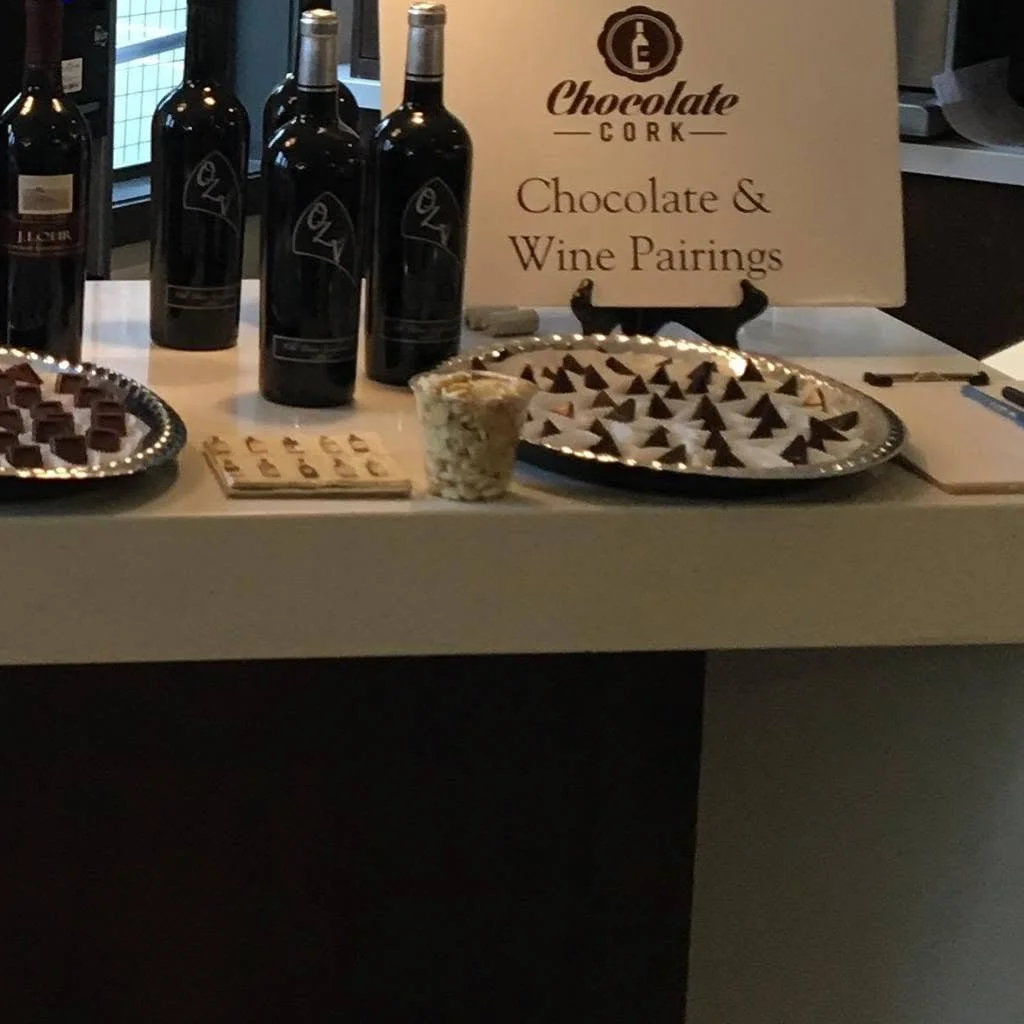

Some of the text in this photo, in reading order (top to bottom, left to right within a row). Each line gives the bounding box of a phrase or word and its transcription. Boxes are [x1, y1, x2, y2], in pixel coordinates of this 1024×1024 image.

[546, 79, 740, 117] Chocolate
[599, 121, 686, 143] CORK
[516, 176, 772, 215] Chocolate &
[508, 235, 783, 280] Wine Pairings
